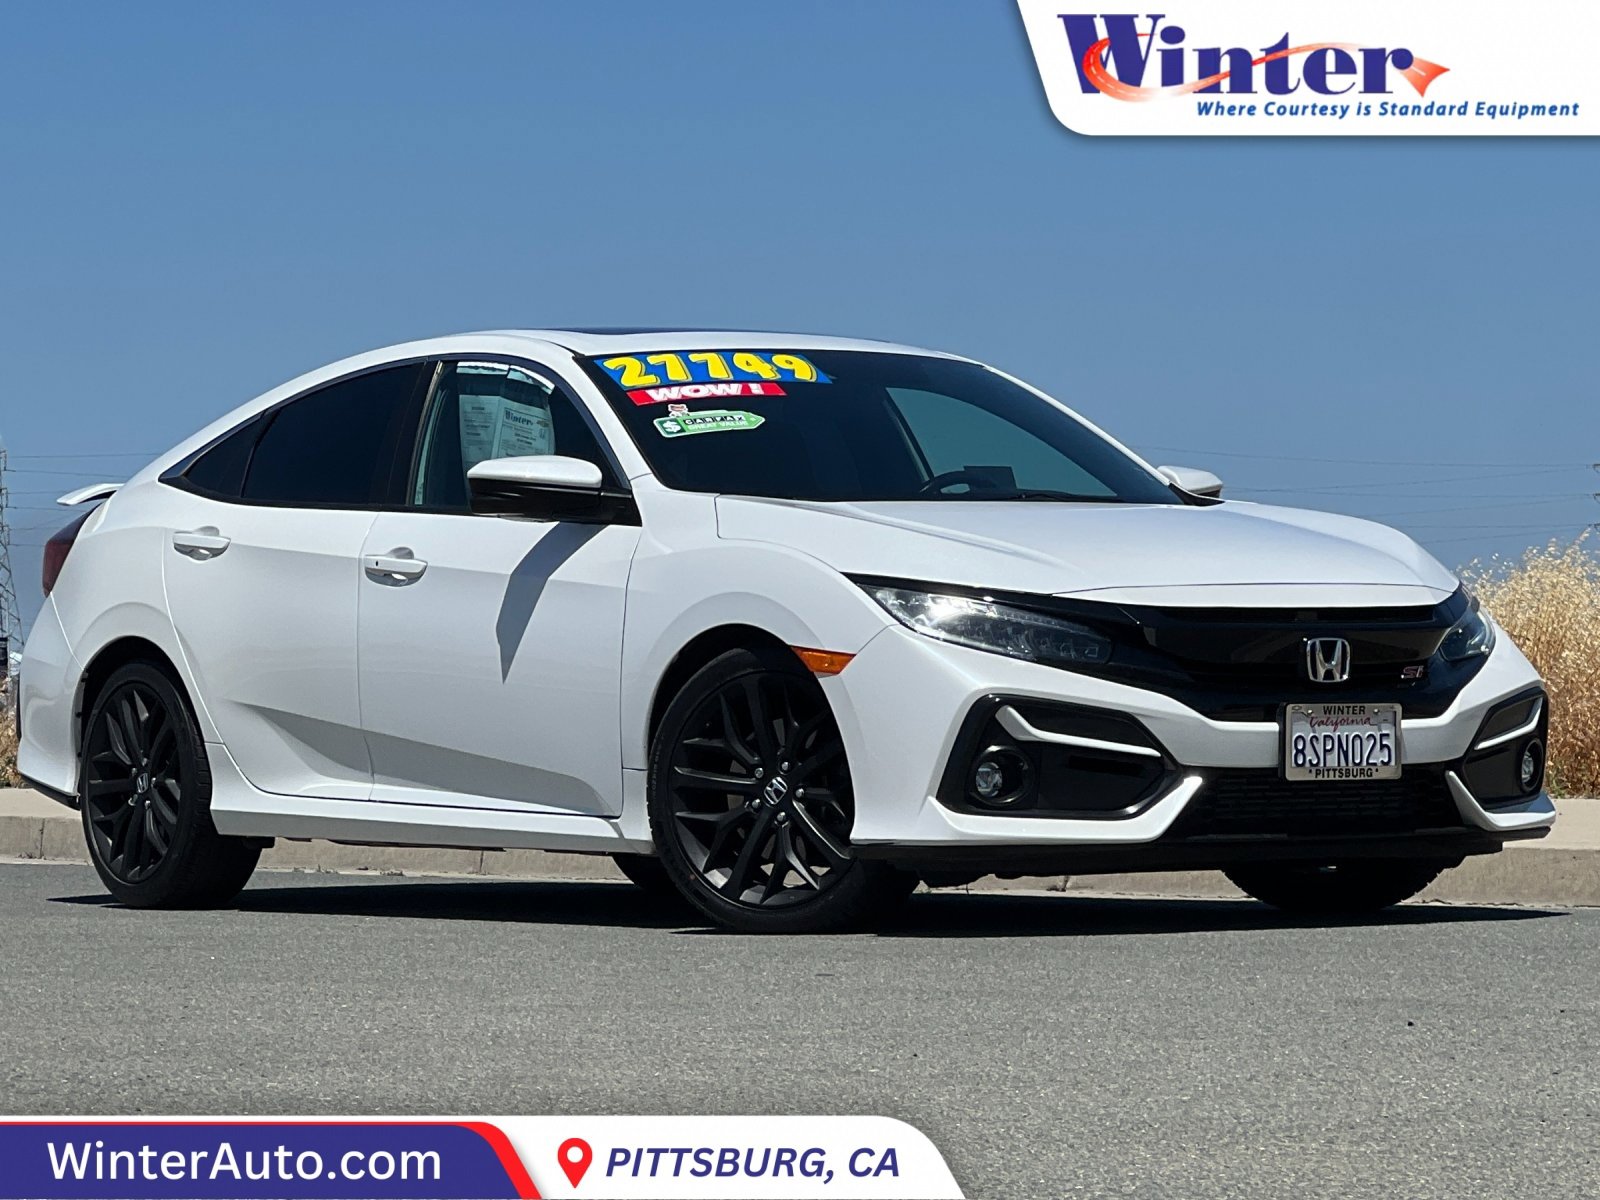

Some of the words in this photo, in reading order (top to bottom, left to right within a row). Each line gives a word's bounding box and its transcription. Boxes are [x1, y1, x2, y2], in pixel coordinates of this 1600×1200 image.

[603, 353, 818, 387] 27749
[1323, 705, 1366, 715] WINTER
[1309, 716, 1379, 732] California
[1293, 732, 1392, 767] 8SPN025
[1315, 768, 1373, 778] PITTSBURG
